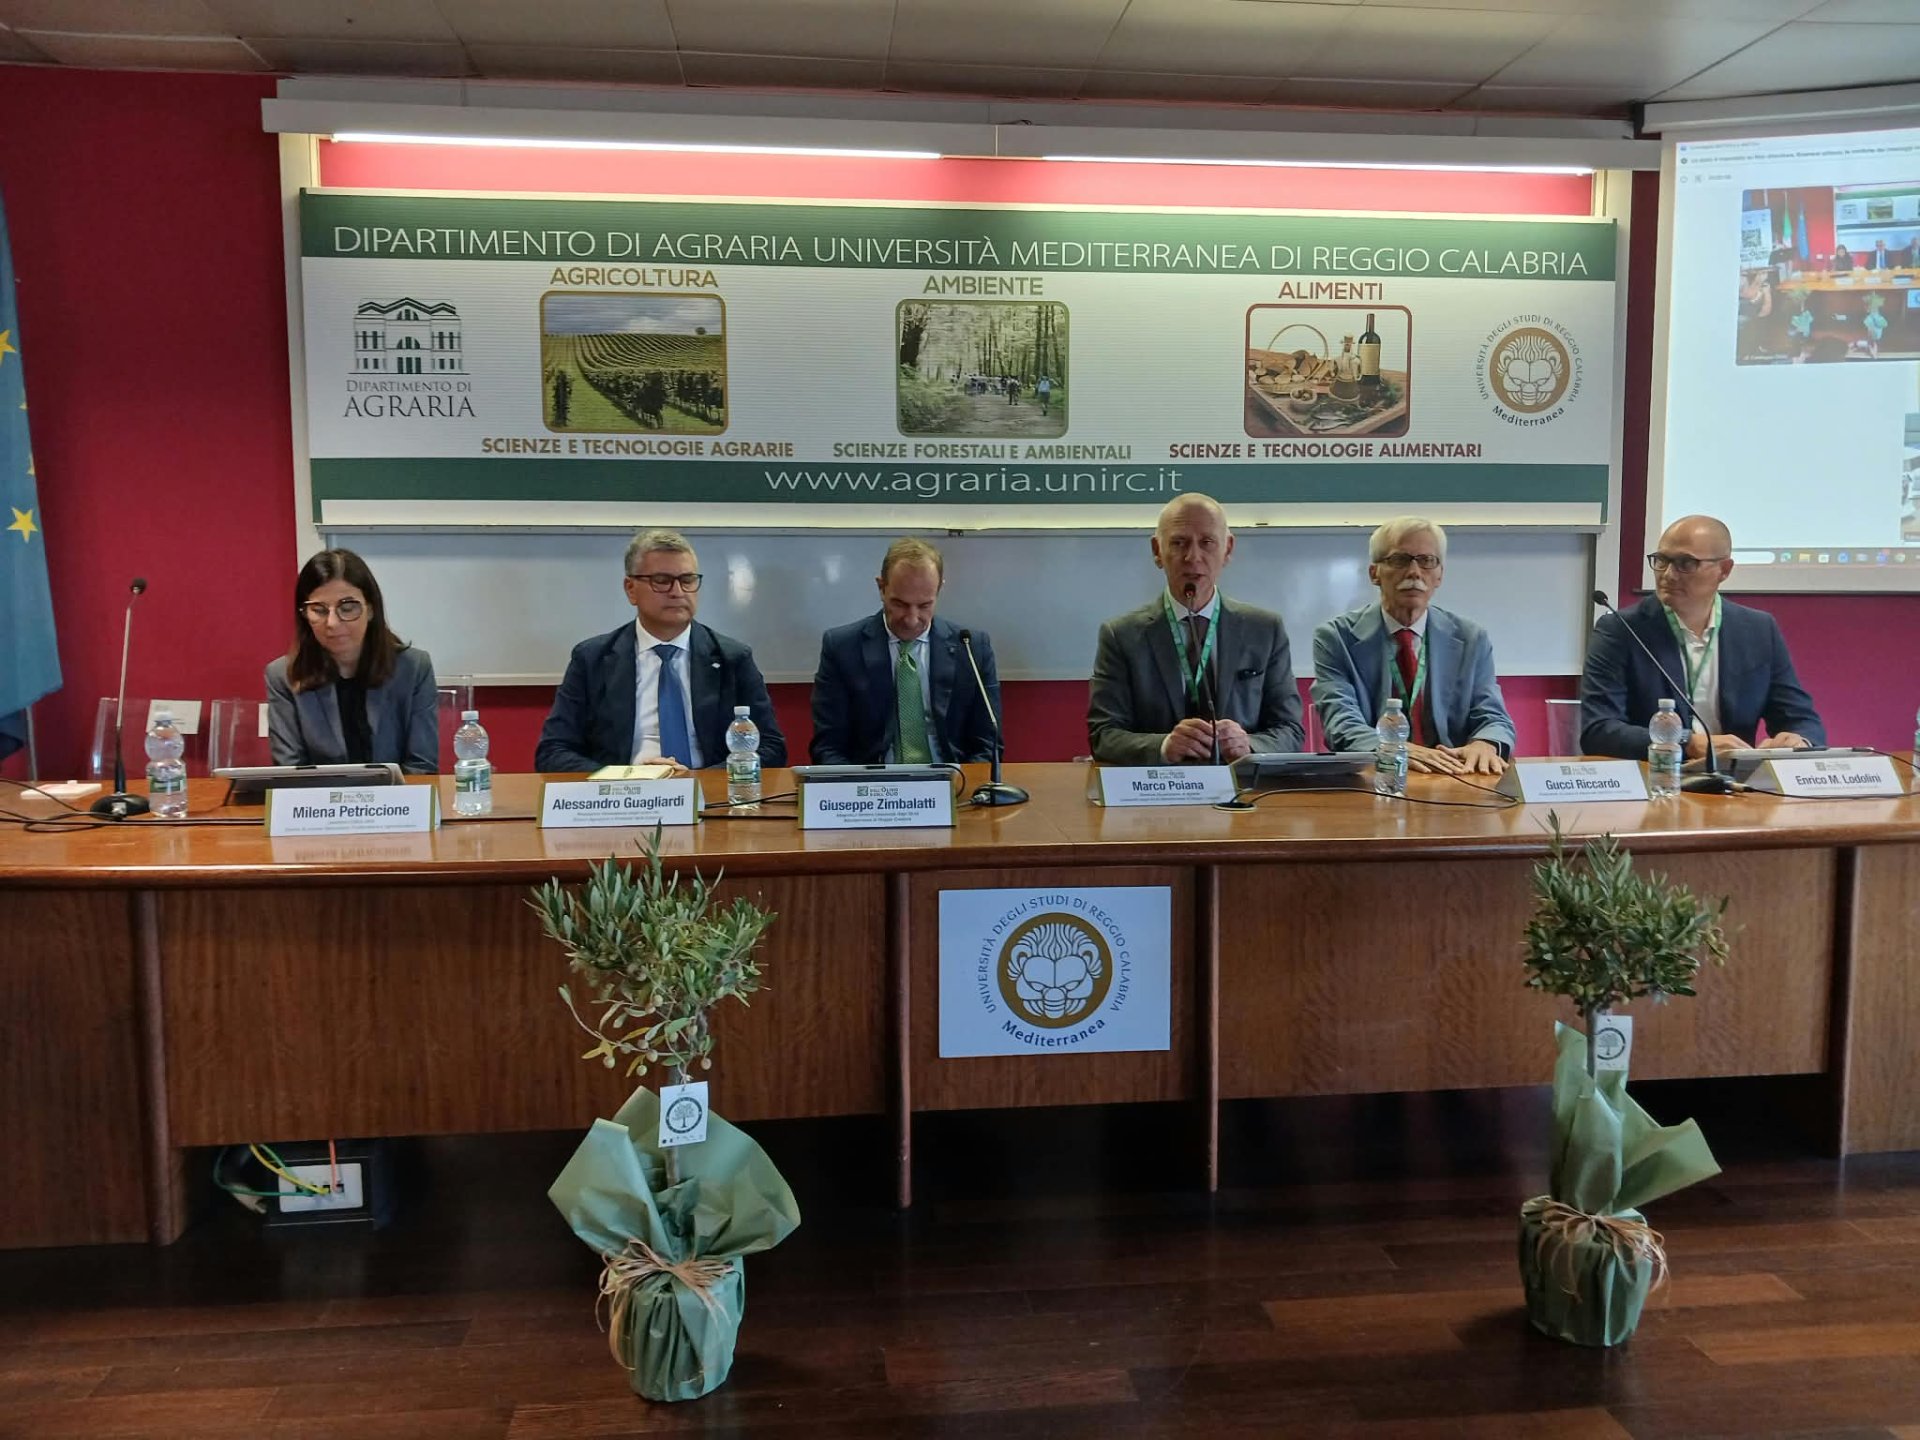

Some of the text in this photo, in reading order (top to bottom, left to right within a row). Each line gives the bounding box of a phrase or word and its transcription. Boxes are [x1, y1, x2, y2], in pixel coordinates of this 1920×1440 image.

[334, 226, 1589, 276] DIPARTIMENTO DI AGRARIA UNIVERSITÀ MEDITERRANEA DI REGGIO CALABRIA
[550, 266, 719, 288] AGRICOLTURA
[922, 275, 1044, 296] AMBIENTE
[1278, 281, 1384, 300] ALIMENTI
[1486, 320, 1512, 343] DEGLI
[1513, 314, 1541, 325] STUDI
[1543, 316, 1554, 327] DI
[1554, 323, 1580, 355] REGGIO
[343, 394, 477, 418] AGRARIA
[1492, 405, 1565, 427] Mediterranea
[481, 437, 794, 457] SCIENZE E TECNOLOGIE AGRARIE
[833, 443, 1132, 460] SCIENZE FORESTALI E AMBIENTALI
[1169, 443, 1482, 458] SCIENZE E TECNOLOGIE ALIMENTARI
[764, 467, 1183, 498] www.agraria.unirc.it
[1132, 780, 1205, 792] Marco Poiana
[1545, 778, 1621, 791] Gucci Riccardo
[1795, 773, 1882, 786] Enrico M. Lodolini
[292, 804, 410, 819] Milena Petriccione
[552, 795, 685, 811] Alessandro Guagliardi
[819, 797, 936, 813] Giuseppe Zimbalatti
[977, 895, 1132, 1014] UNIVERSITÀ DEGLI STUDI DI REGGIO CALABRIA
[1001, 1018, 1106, 1047] Mediterranea
